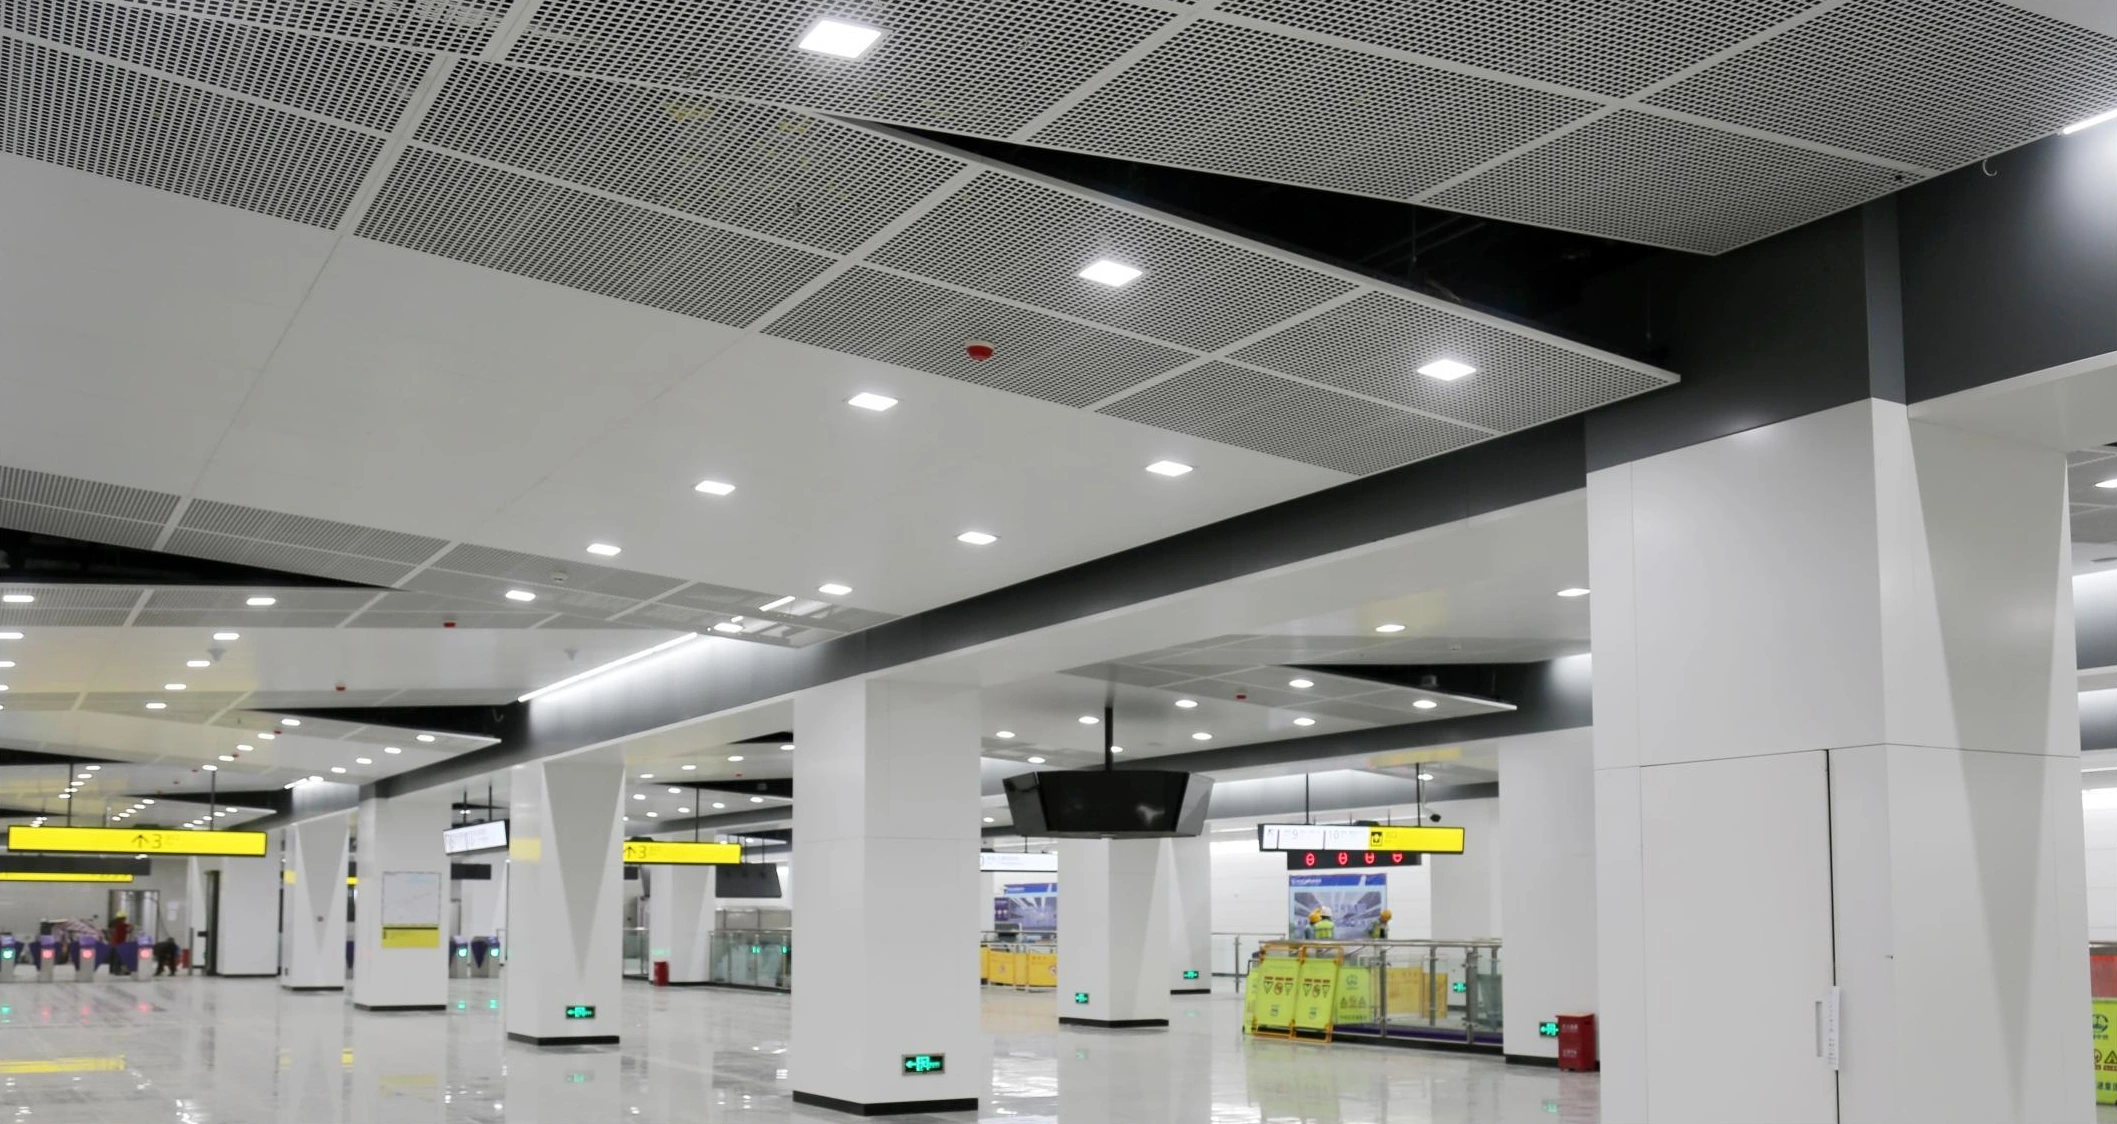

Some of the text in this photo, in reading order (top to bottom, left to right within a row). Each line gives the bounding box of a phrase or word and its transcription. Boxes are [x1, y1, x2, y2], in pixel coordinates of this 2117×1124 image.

[151, 833, 163, 849] 3
[1292, 829, 1298, 840] 9
[1329, 829, 1340, 840] 10
[638, 844, 647, 859] 3
